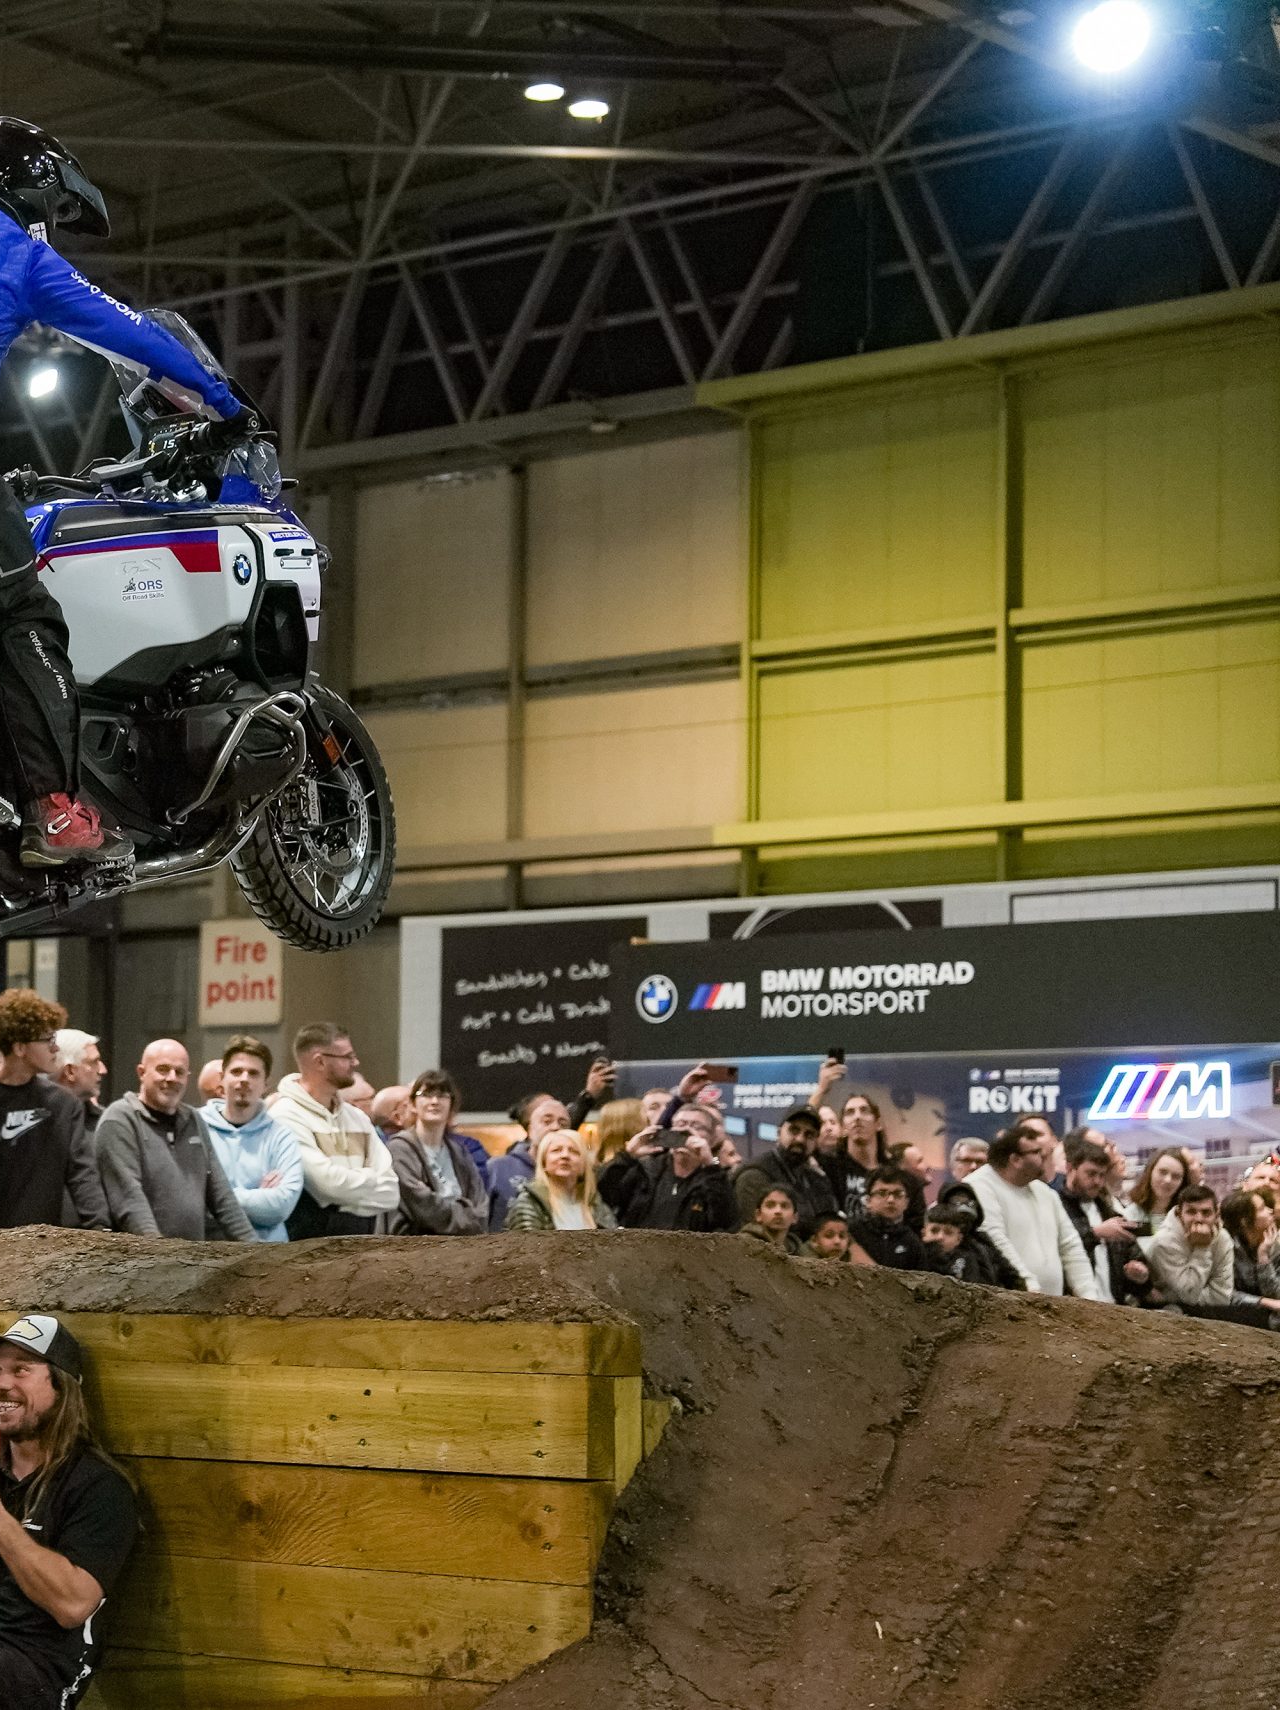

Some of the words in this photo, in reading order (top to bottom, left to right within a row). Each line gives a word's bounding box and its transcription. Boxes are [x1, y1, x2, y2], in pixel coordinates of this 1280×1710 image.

[138, 580, 163, 591] ORS
[56, 674, 68, 699] BMW
[215, 935, 267, 964] Fire
[207, 973, 275, 1008] point
[761, 968, 825, 993] BMW
[829, 961, 976, 990] MOTORRAD
[761, 989, 931, 1019] MOTORSPORT
